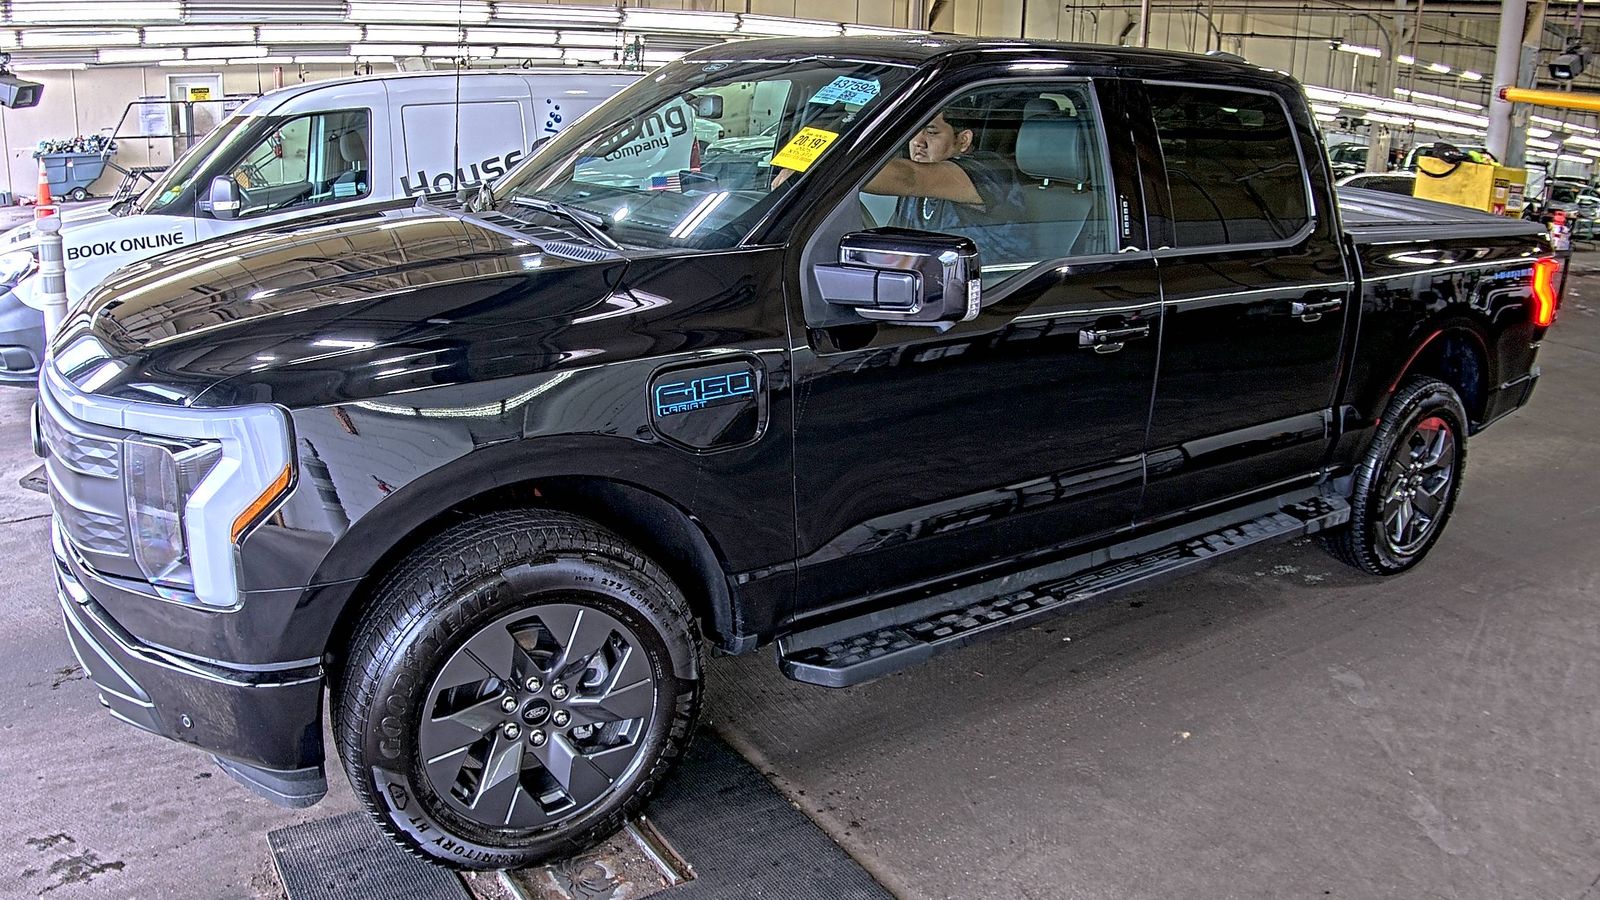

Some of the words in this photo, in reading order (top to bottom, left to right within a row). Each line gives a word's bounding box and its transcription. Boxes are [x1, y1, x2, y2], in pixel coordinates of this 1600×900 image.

[67, 241, 117, 260] BOOK
[120, 232, 184, 252] ONLINE
[656, 371, 754, 414] F-150
[663, 401, 708, 415] LARIAT
[409, 816, 430, 833] HT
